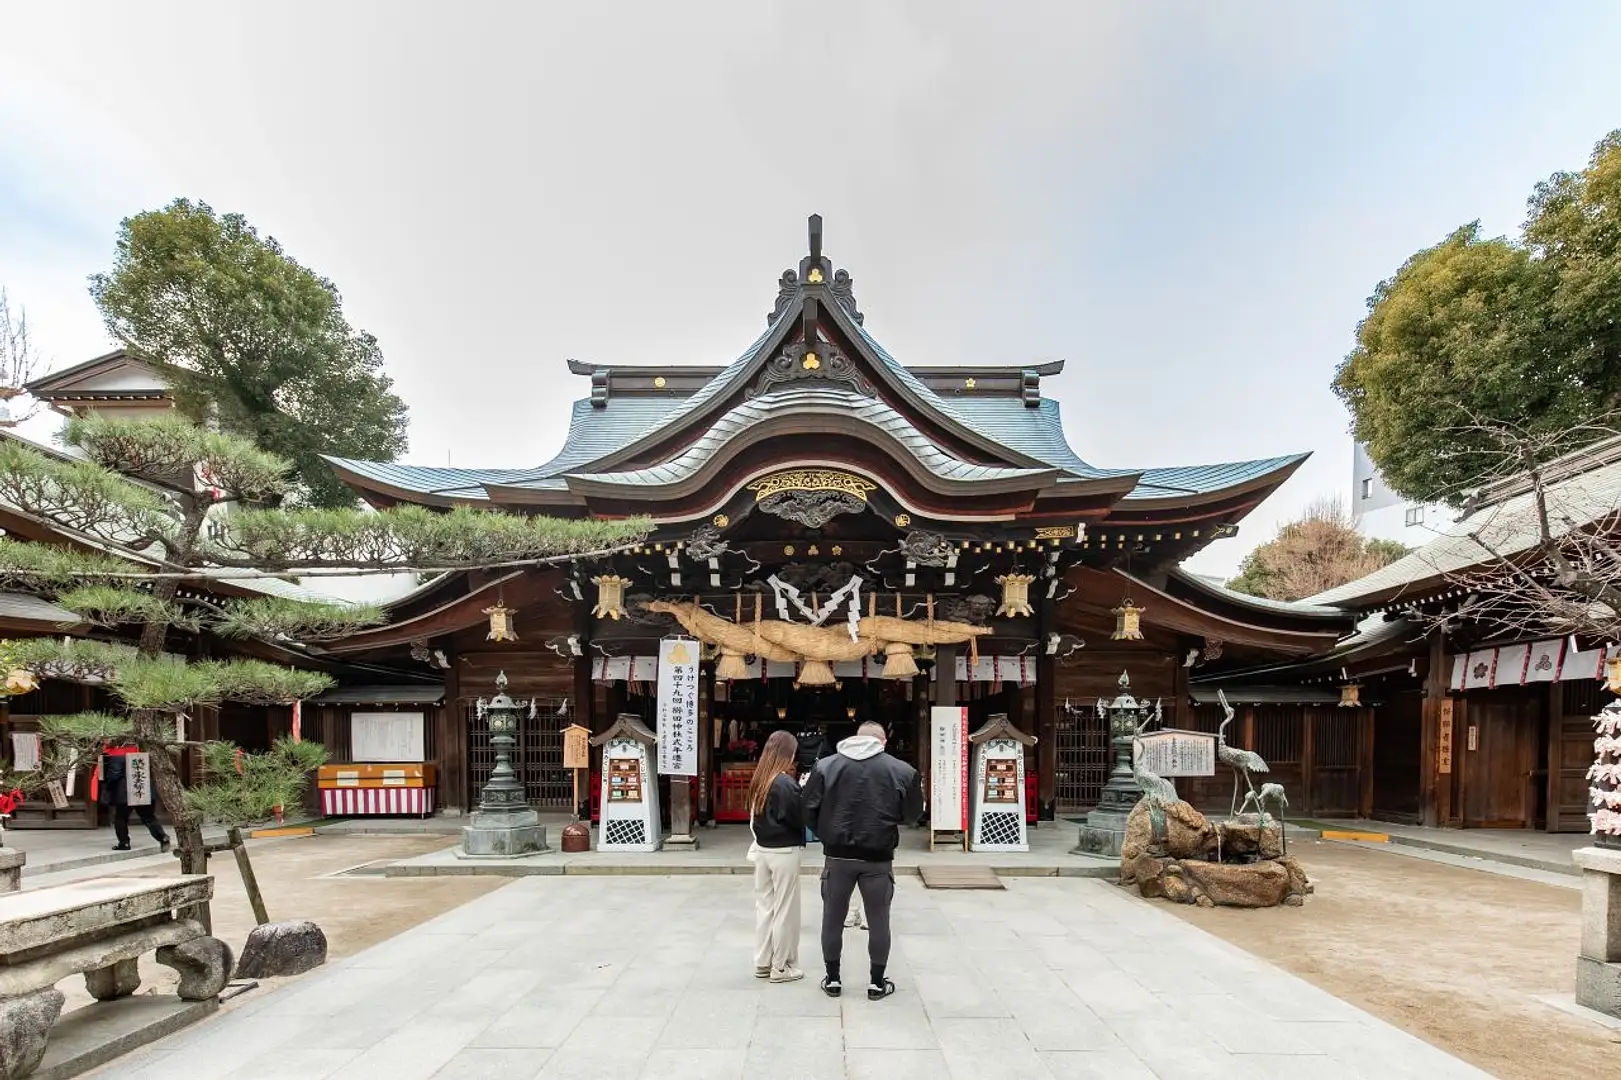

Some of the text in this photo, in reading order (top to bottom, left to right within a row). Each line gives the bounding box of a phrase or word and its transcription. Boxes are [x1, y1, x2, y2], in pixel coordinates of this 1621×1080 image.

[686, 665, 695, 752] うけつぐ博多のこころ
